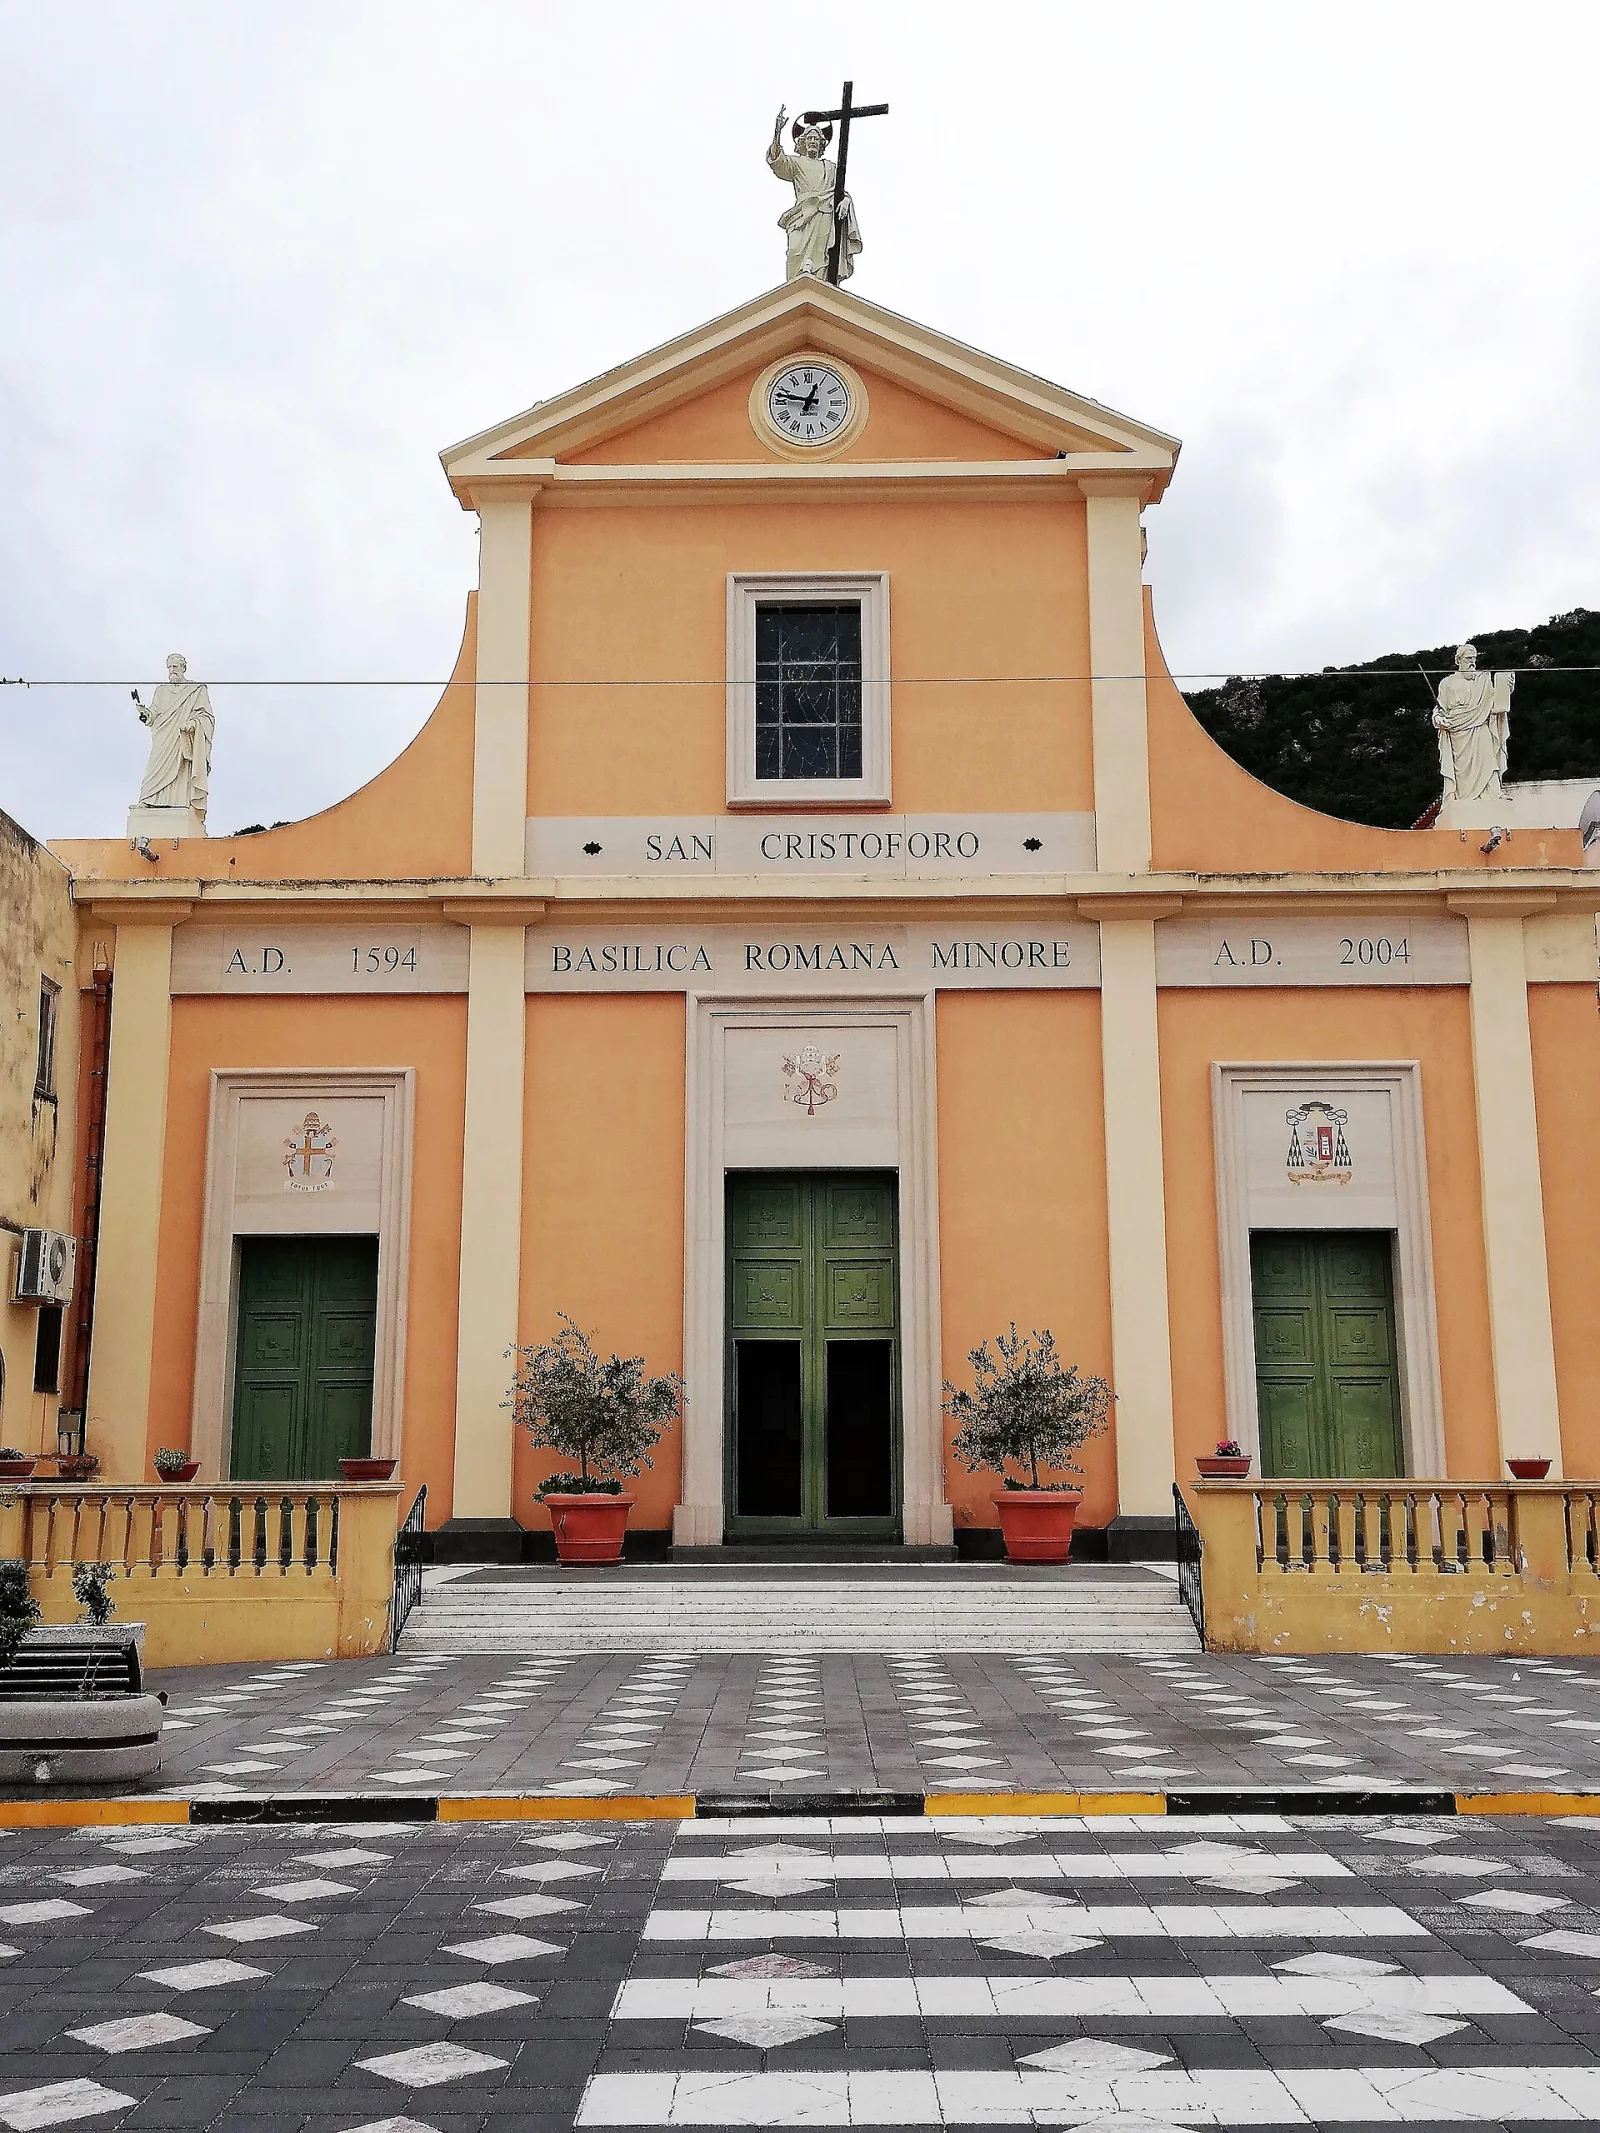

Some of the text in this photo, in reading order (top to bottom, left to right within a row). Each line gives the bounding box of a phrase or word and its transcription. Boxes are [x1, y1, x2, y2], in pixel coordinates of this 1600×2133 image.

[803, 372, 813, 384] XII
[646, 831, 980, 861] SAN CRISTOFORO
[225, 946, 417, 974] A.D. 1594
[551, 941, 1072, 972] BASILICA ROMANA MINORE
[1213, 937, 1411, 966] A.D. 2004
